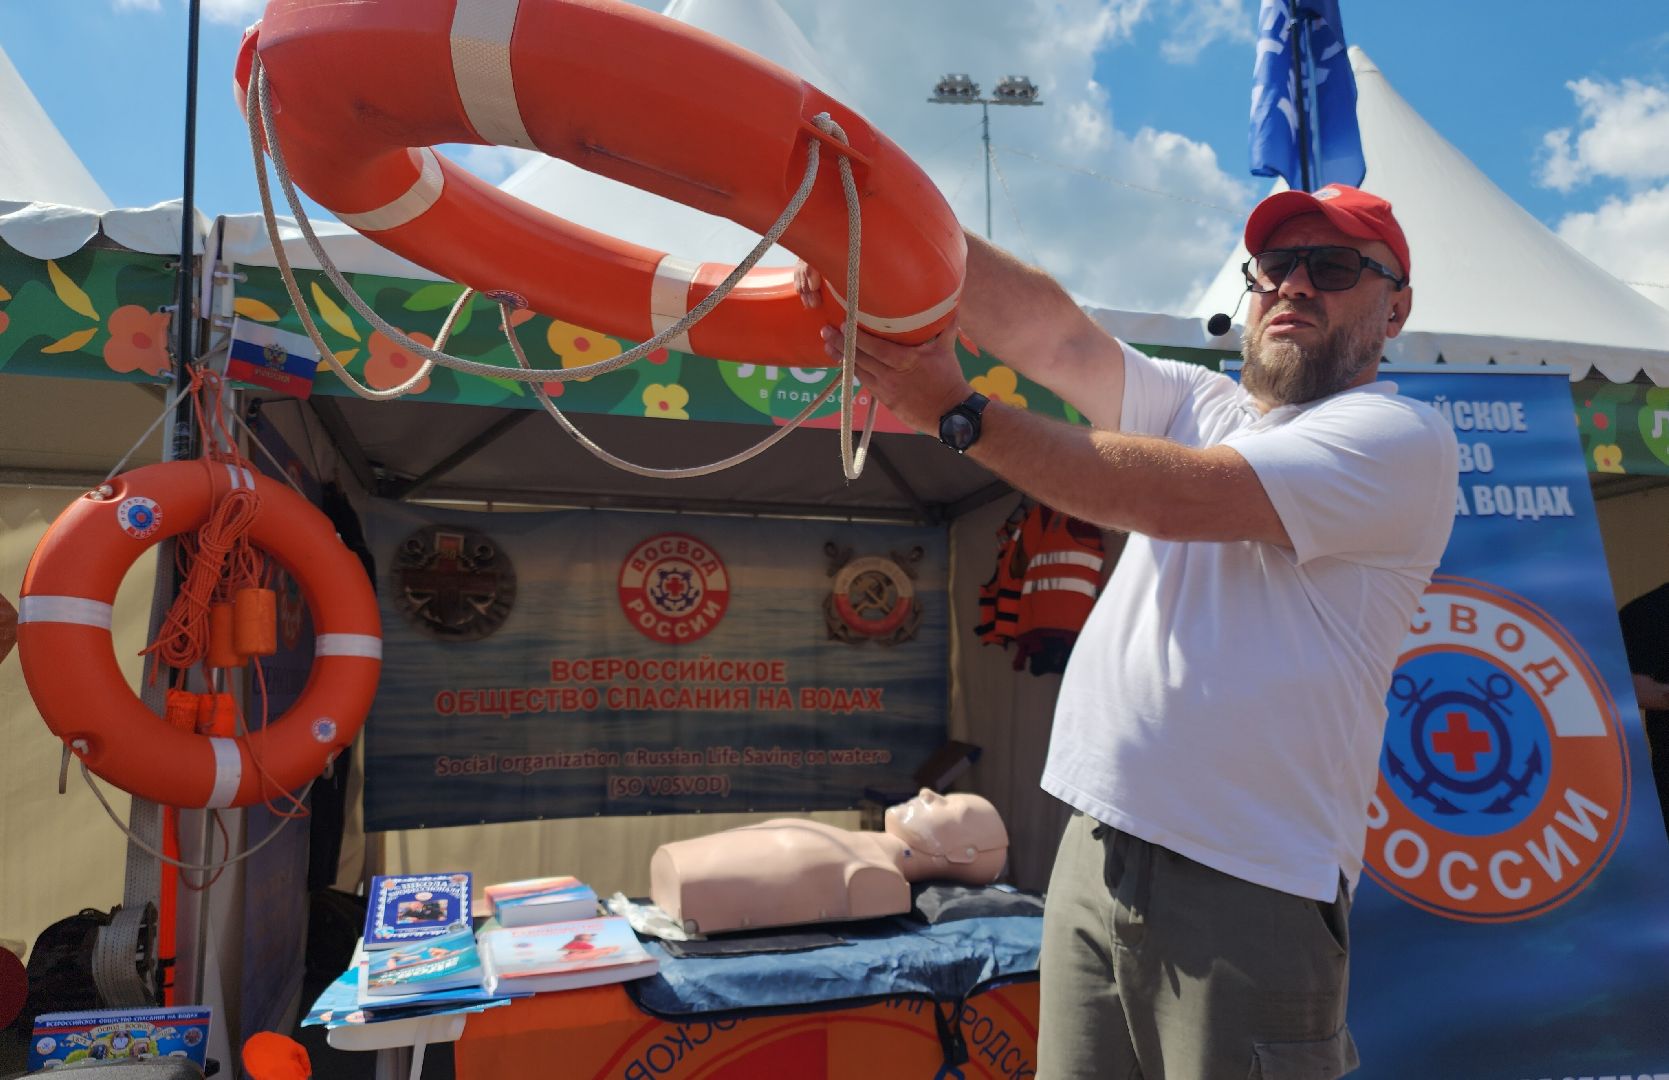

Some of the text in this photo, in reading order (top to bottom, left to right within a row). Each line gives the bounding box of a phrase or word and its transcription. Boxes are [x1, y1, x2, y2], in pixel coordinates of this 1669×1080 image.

[1425, 396, 1528, 432] ЙСКОЕ
[1458, 443, 1494, 473] ВО
[1455, 486, 1575, 521] А ВОДАХ
[632, 541, 719, 576] ВОСВОД
[627, 598, 721, 638] РОССИИ
[1409, 603, 1570, 696] СВОД
[551, 655, 786, 683] ВСЕРОССИЙСКОЕ
[435, 686, 885, 718] ОБЩЕСТВО СПАСАНИЯ НА ВОДАХ
[435, 753, 496, 777] Social
[501, 751, 619, 774] organization
[706, 748, 740, 766] Life
[744, 748, 800, 769] Saving
[607, 774, 732, 799] (SO VOSVOD)
